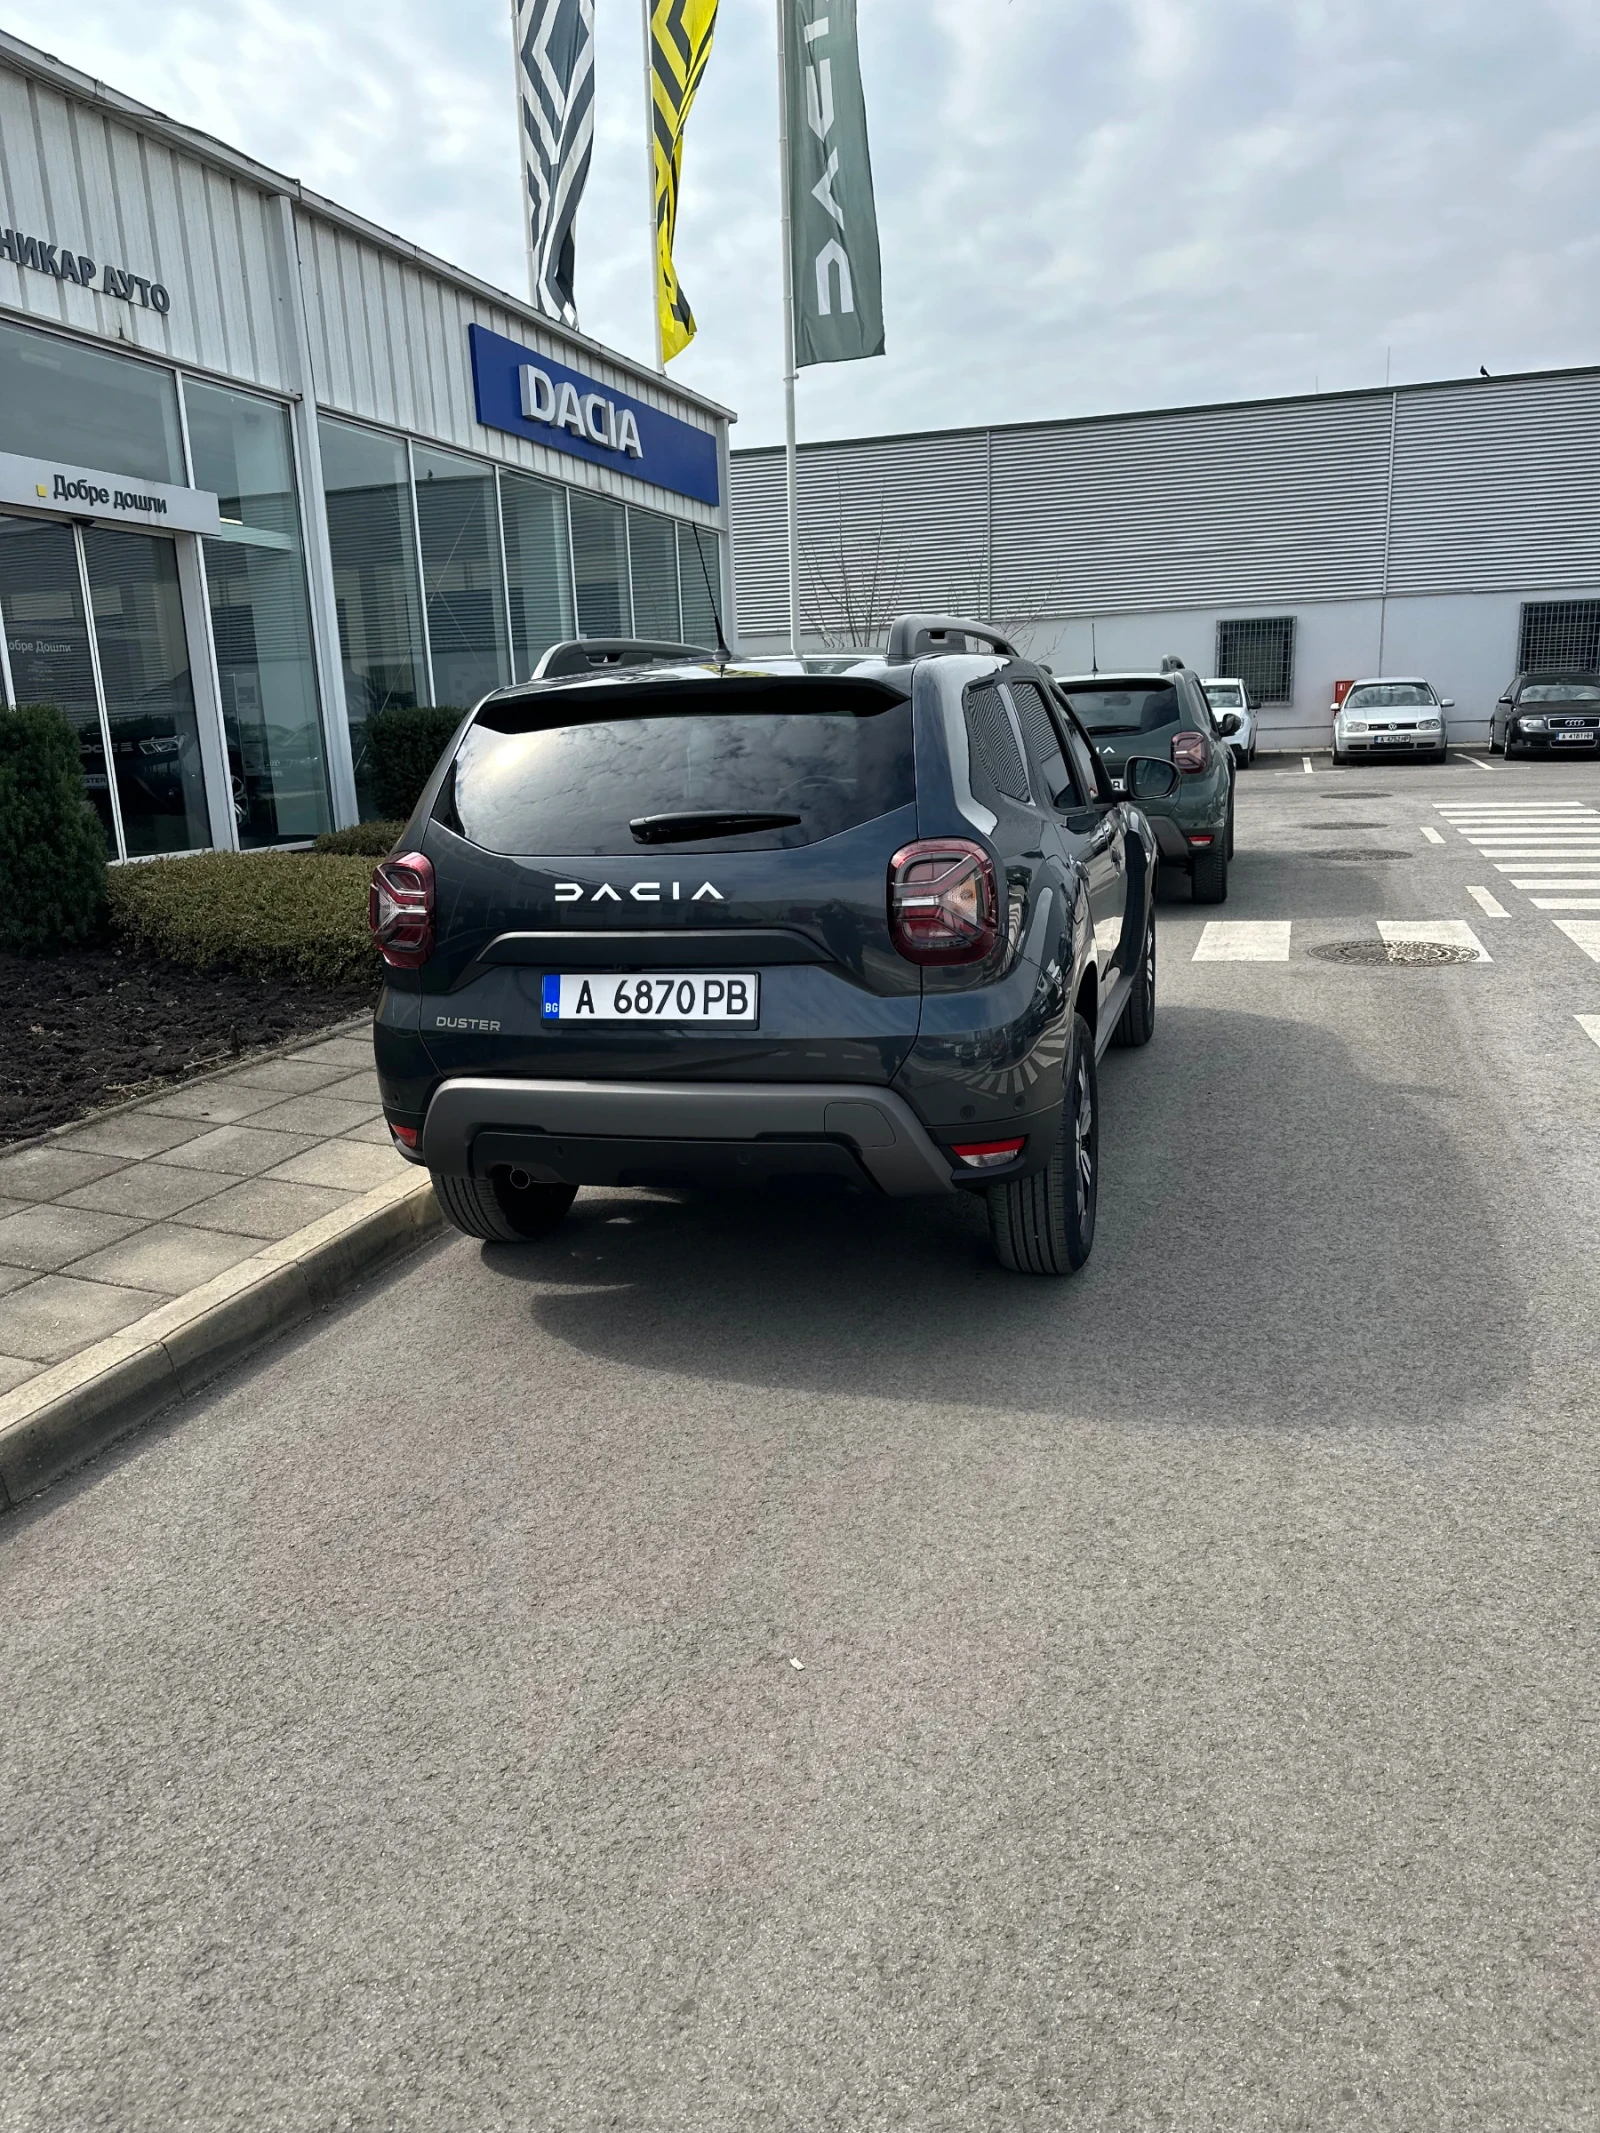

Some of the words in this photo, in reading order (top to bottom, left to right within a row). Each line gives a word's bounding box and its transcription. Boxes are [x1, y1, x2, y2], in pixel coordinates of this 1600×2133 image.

[103, 265, 171, 313] АУТО
[519, 364, 643, 459] DACIA
[53, 474, 110, 506] Добре
[113, 490, 168, 514] дошли
[8, 640, 34, 653] обре
[555, 881, 724, 901] DACIA
[545, 1003, 559, 1013] BG
[436, 1016, 501, 1031] DUSTER
